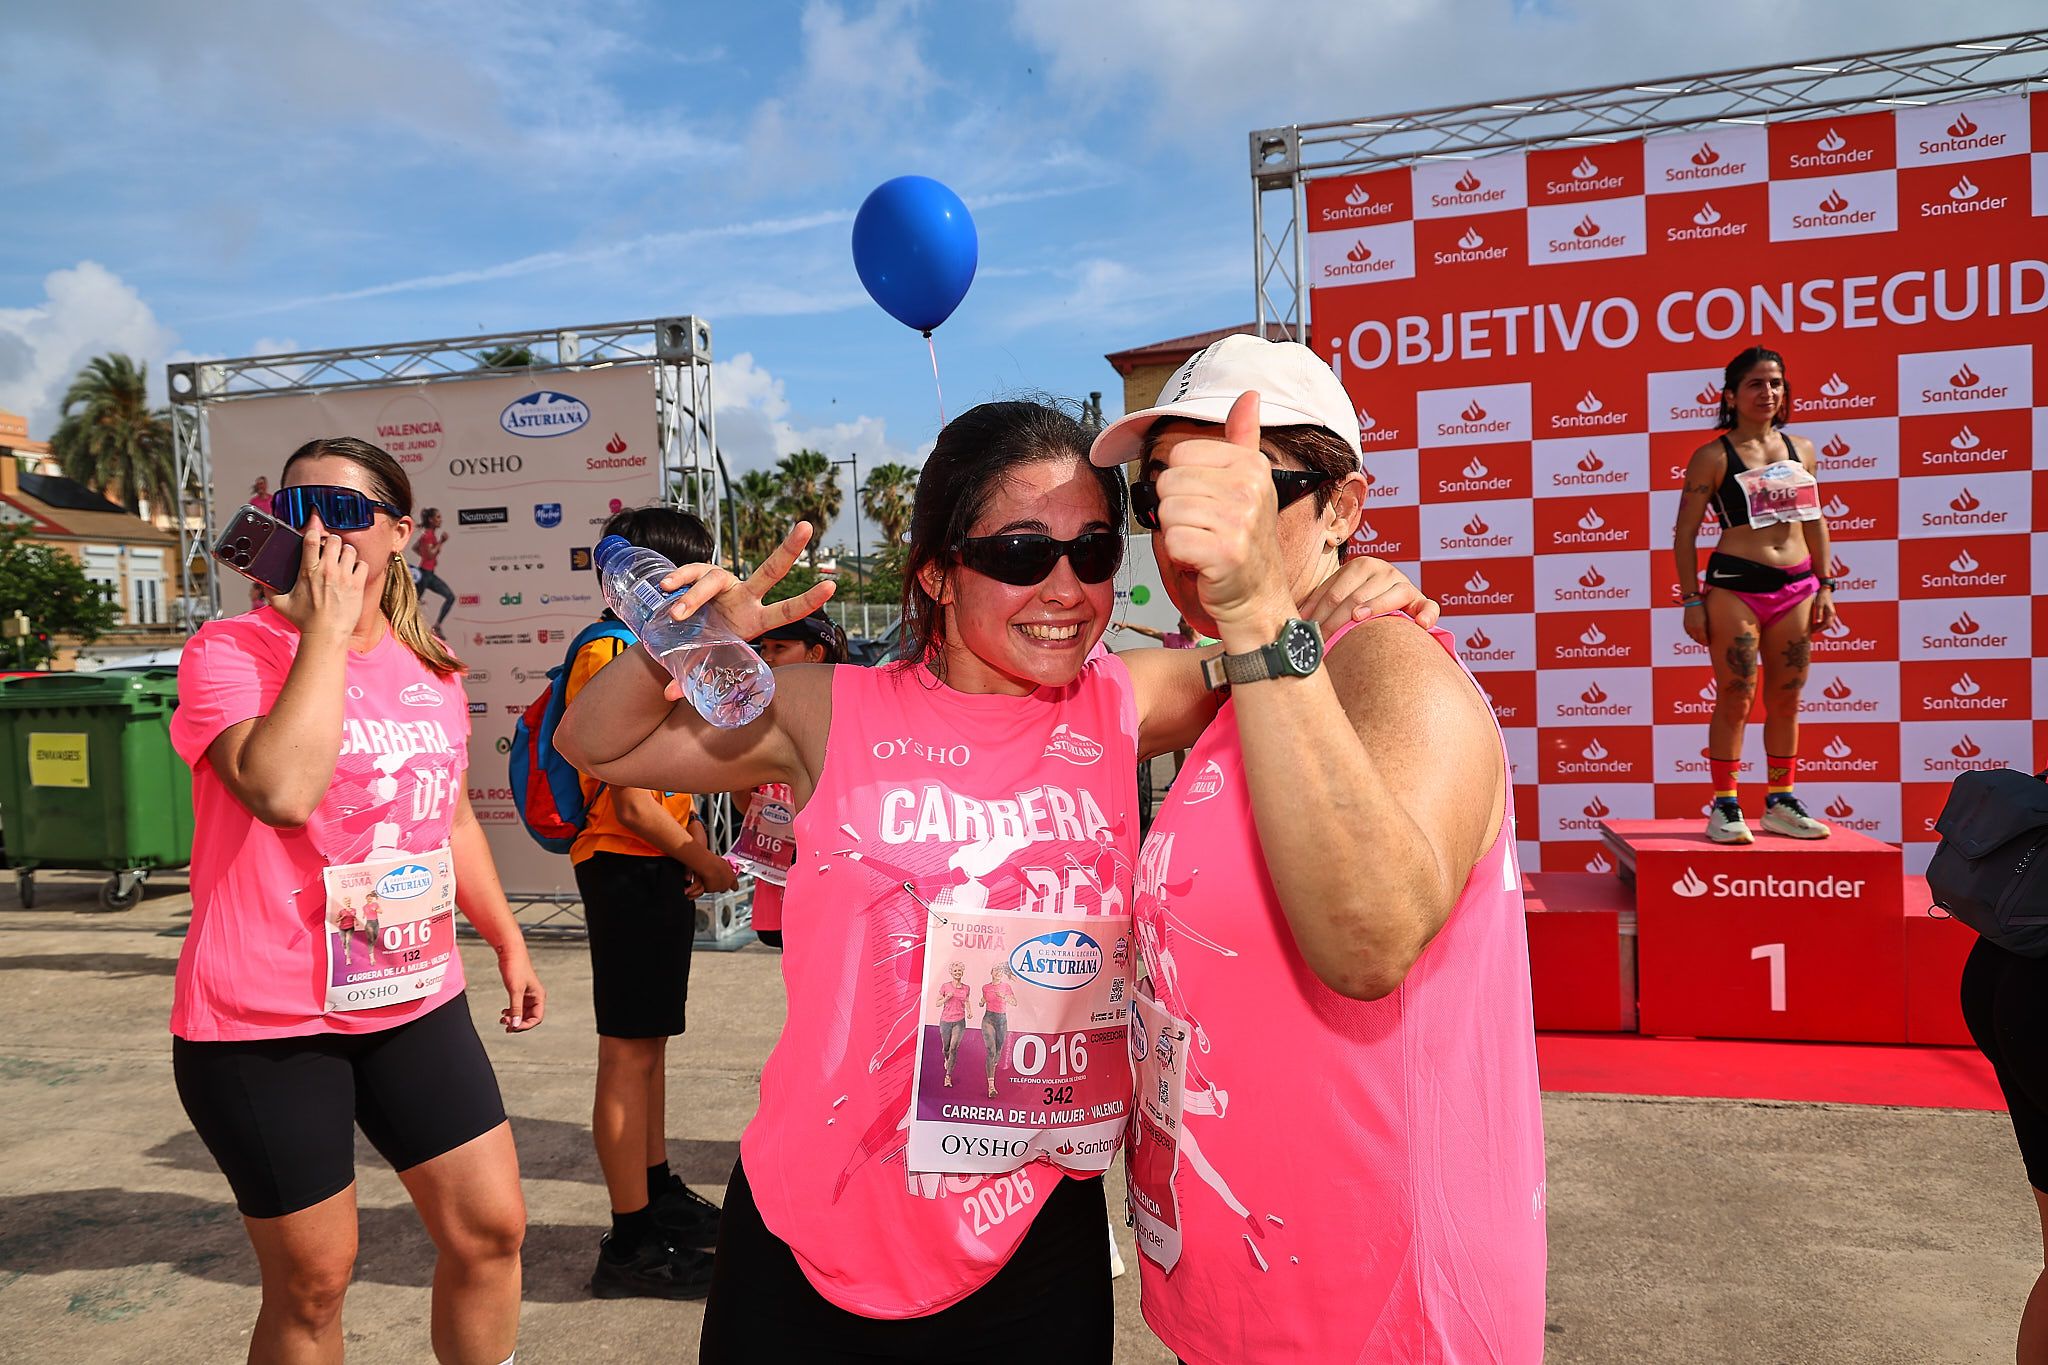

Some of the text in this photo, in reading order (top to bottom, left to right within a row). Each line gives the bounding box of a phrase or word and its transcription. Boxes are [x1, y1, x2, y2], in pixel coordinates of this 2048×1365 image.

[1919, 132, 2006, 154] Santander
[1790, 148, 1874, 168] Santander
[1666, 161, 1746, 182] Santander
[1546, 175, 1624, 195] Santander
[1432, 187, 1505, 207] Santander
[1322, 201, 1394, 221] Santander
[1921, 196, 2008, 217] Santander
[1793, 209, 1876, 229] Santander
[1667, 222, 1747, 241] Santander
[1549, 233, 1626, 253] Santander
[1434, 245, 1508, 264] Santander
[1324, 258, 1395, 277] Santander
[1331, 297, 1640, 382] ¡OBJETIVO
[1922, 385, 2008, 403] Santander
[1793, 394, 1877, 412] Santander
[507, 410, 583, 428] ASTURIANA
[1438, 419, 1512, 436] Santander
[1552, 411, 1628, 429] Santander
[377, 421, 443, 438] VALENCIA
[1360, 428, 1399, 442] ander
[392, 442, 404, 451] DE
[406, 439, 437, 451] JUNIO
[399, 453, 424, 463] 2026
[586, 455, 648, 470] Santander
[1816, 455, 1878, 470] ntander
[1922, 448, 2008, 465] Santander
[449, 455, 523, 477] OYSHO
[1439, 477, 1512, 493] Santander
[1553, 470, 1629, 487] Santander
[1769, 487, 1797, 501] 016
[461, 510, 506, 523] Neutrogena
[1923, 511, 2008, 527] Santander
[1440, 534, 1513, 550] Santander
[1553, 528, 1629, 545] Santander
[1347, 540, 1401, 555] ntander
[490, 563, 545, 572] VOLVO
[1835, 576, 1877, 591] ander
[1922, 572, 2007, 588] Santander
[1441, 591, 1514, 607] Santander
[1554, 586, 1630, 602] Santander
[1923, 634, 2008, 649] Santander
[1458, 647, 1515, 661] ntander
[1556, 643, 1631, 659] Santander
[1557, 702, 1632, 717] Santander
[1797, 699, 1879, 713] Santander
[1923, 696, 2008, 710] Santander
[872, 737, 971, 767] OYSHO
[1557, 759, 1633, 774] Santander
[1796, 758, 1878, 772] Santander
[1924, 757, 2009, 771] Santander
[879, 784, 1114, 844] CARRERA
[756, 833, 783, 853] 016
[341, 876, 373, 889] SUMA
[381, 877, 431, 895] ASTURIANA
[1713, 873, 1865, 898] Santander
[383, 920, 432, 950] 016
[951, 922, 964, 932] TU
[952, 933, 1005, 950] SUMA
[403, 949, 421, 963] 132
[1039, 949, 1075, 957] CENTRAL
[1018, 949, 1097, 975] ASTURIANA
[346, 968, 383, 983] CARRERA
[384, 967, 395, 977] DE
[395, 965, 406, 975] LA
[1750, 943, 1787, 1012] 1
[347, 984, 399, 1002] OYSHO
[1012, 1032, 1088, 1076] 016
[1043, 1086, 1073, 1105] 342
[942, 1100, 1125, 1125] CARRERA DE LA MUJER VALENCIA
[941, 1134, 1029, 1157] OYSHO
[963, 1168, 1035, 1236] 2026
